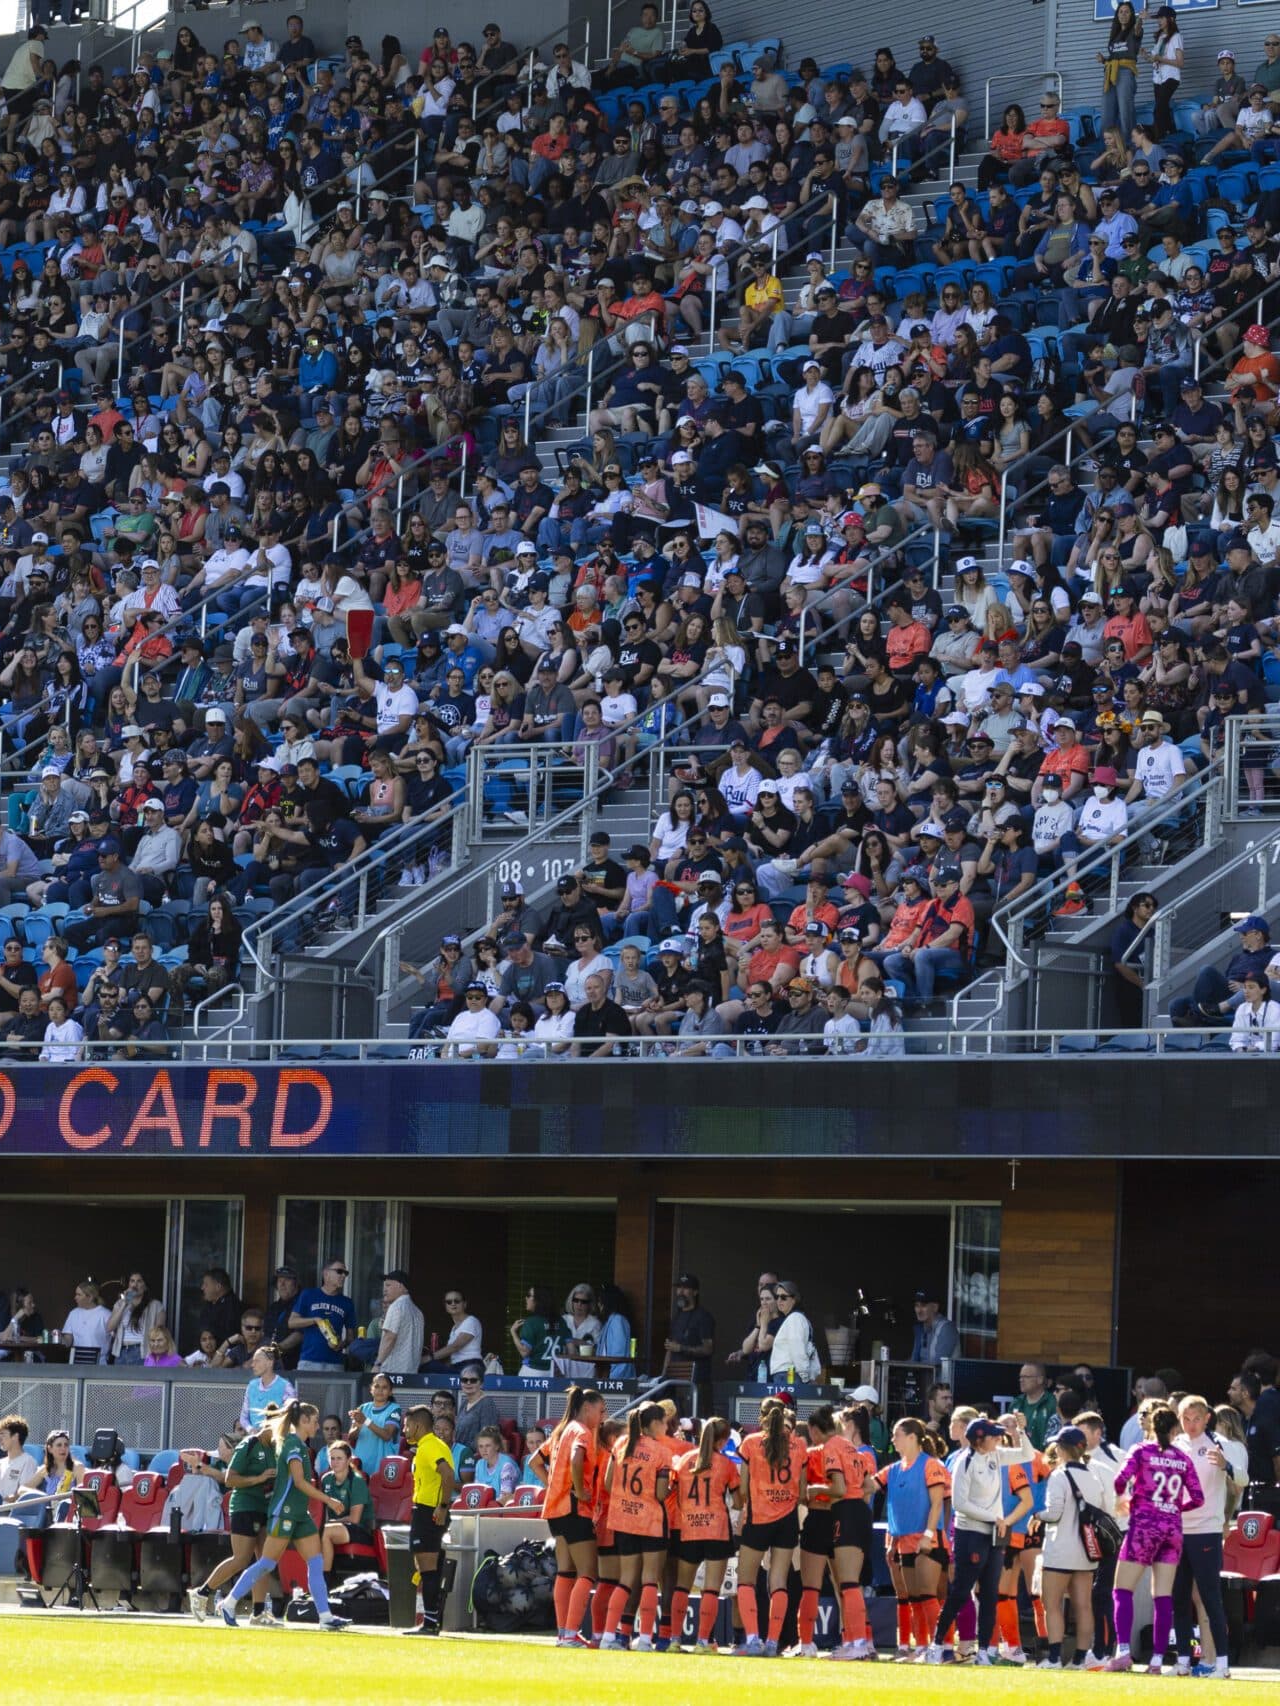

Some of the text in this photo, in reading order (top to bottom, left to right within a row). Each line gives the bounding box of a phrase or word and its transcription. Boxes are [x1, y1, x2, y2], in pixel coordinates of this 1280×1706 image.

[495, 860, 521, 883] 08
[58, 1067, 334, 1149] CARD
[522, 1379, 550, 1389] TIXR
[596, 1381, 624, 1391] TIXR
[1149, 1456, 1187, 1471] SILKOWITZ
[622, 1463, 643, 1496] 16
[687, 1475, 711, 1507] 41
[1151, 1471, 1183, 1503] 29
